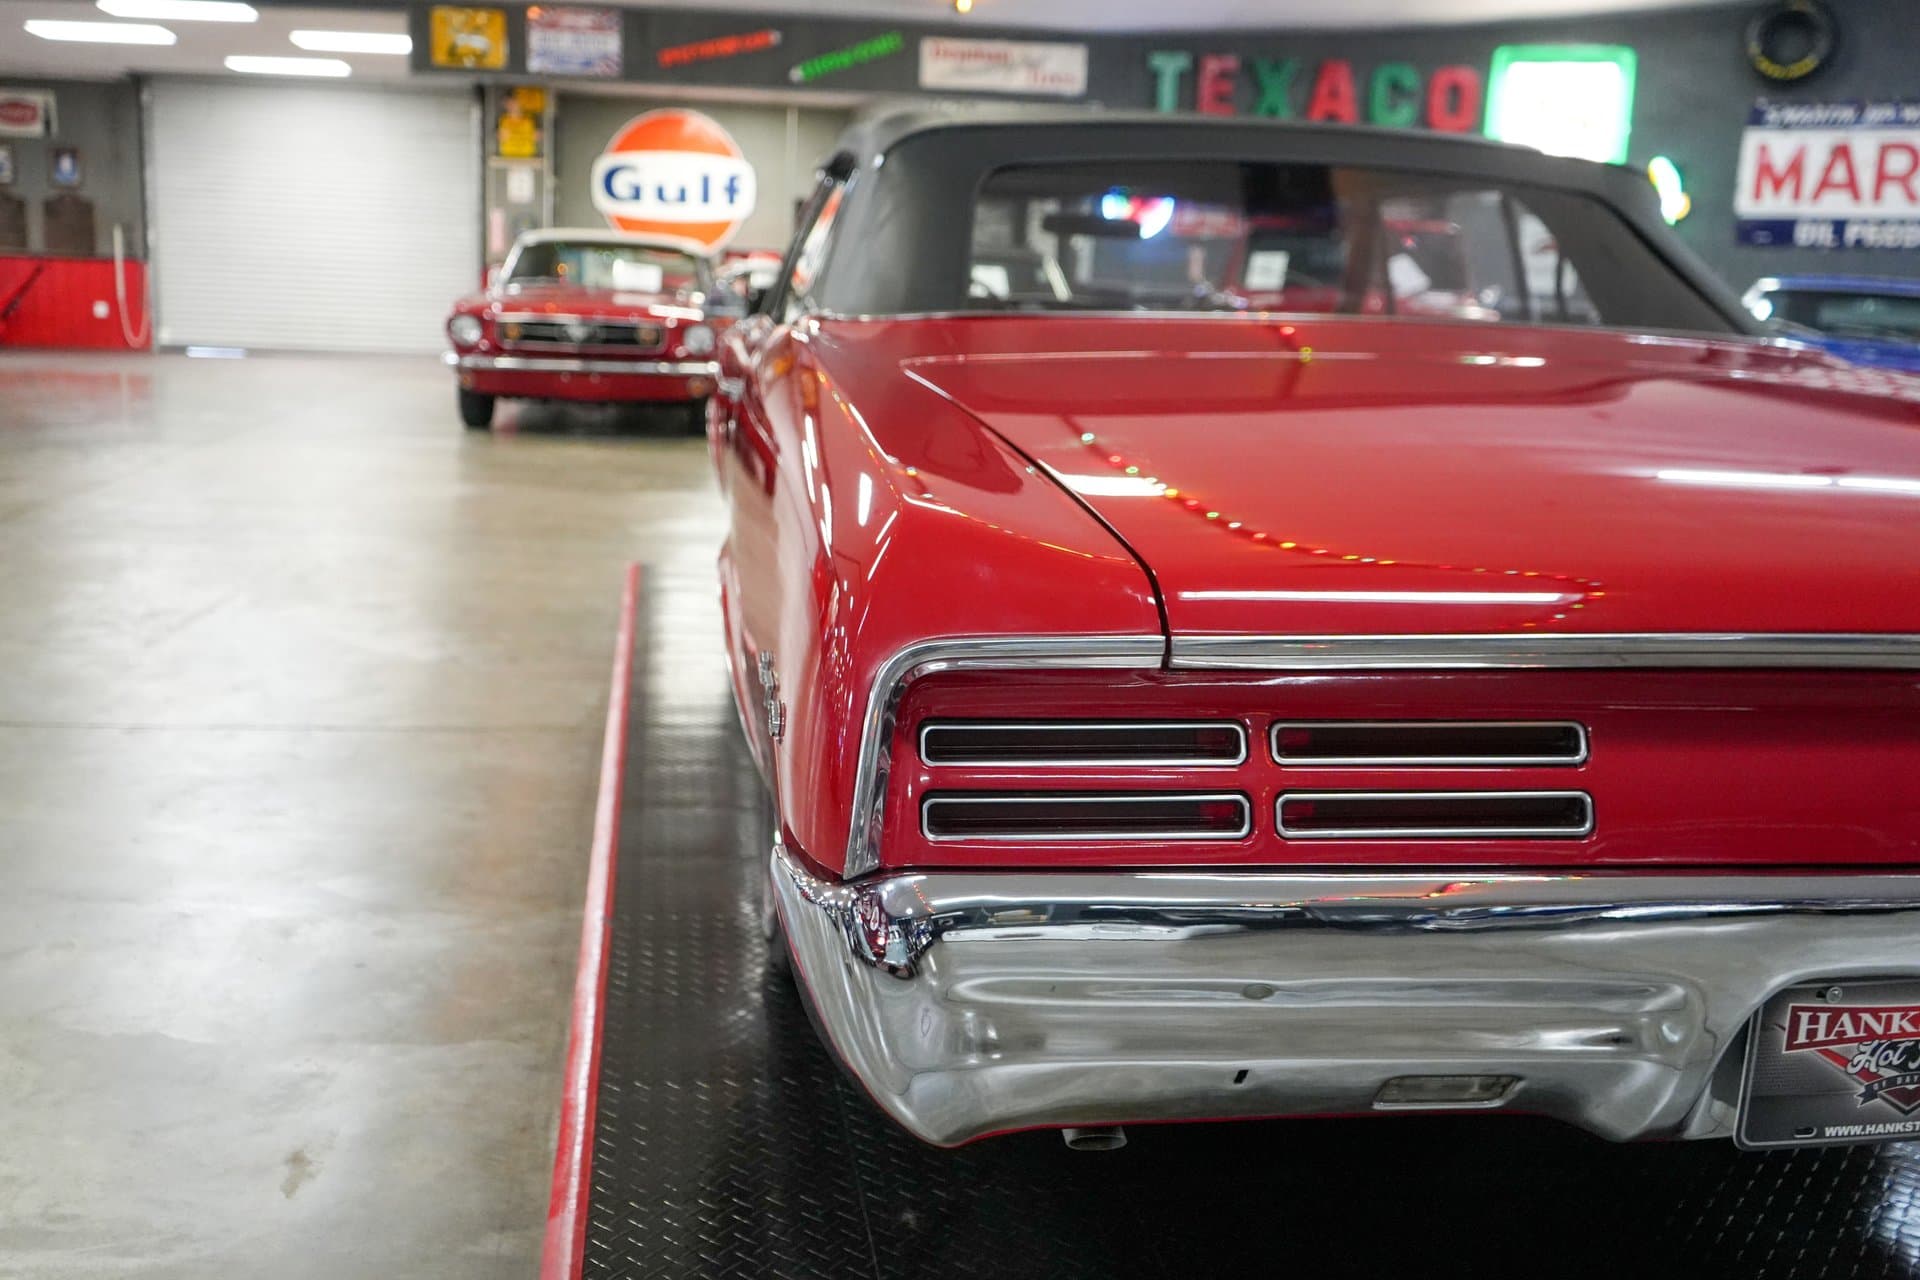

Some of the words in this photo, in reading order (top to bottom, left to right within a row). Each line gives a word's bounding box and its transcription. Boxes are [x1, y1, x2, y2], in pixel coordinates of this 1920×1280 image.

[1149, 51, 1480, 132] TEXACO
[603, 165, 740, 204] Gulf
[1753, 142, 1920, 203] MAR
[1793, 1010, 1920, 1045] HANK
[1847, 1039, 1916, 1073] Hot
